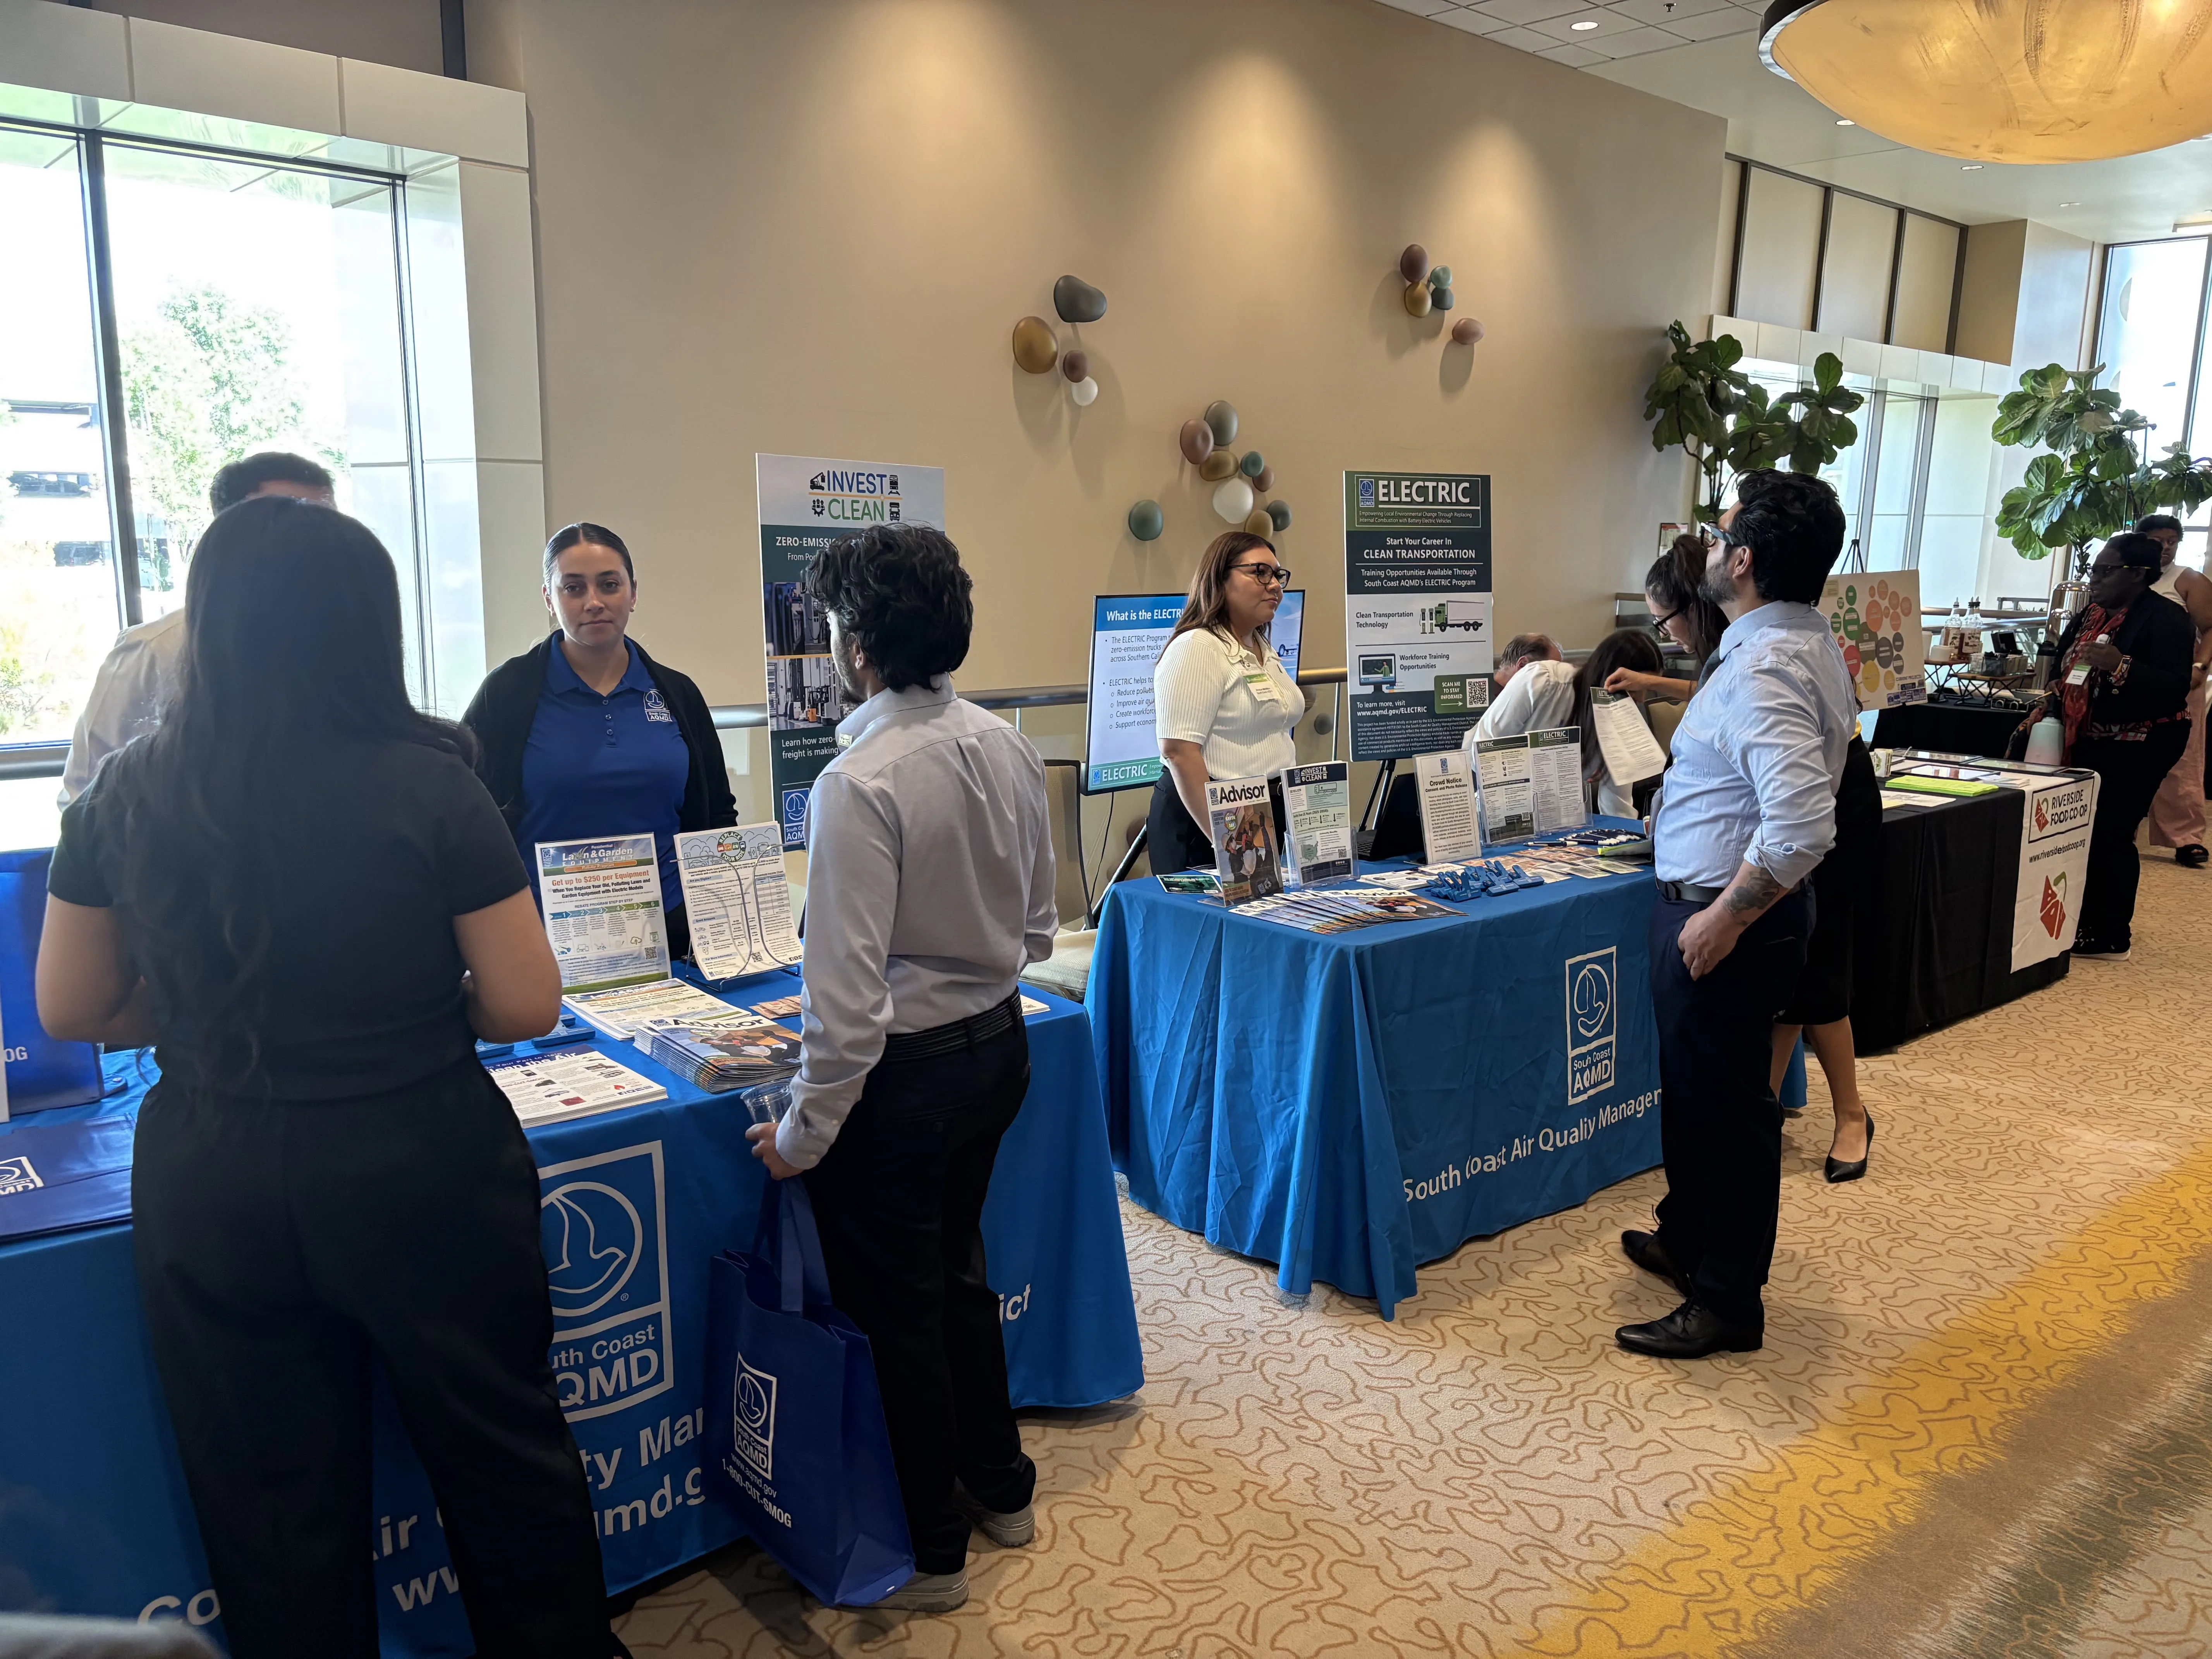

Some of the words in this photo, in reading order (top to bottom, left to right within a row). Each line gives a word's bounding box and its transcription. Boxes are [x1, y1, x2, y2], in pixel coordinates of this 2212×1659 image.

[827, 470, 887, 494] INVEST
[1378, 480, 1470, 503] ELECTRIC
[828, 498, 884, 522] CLEAN
[776, 537, 836, 548] ZERO-EMISSI
[788, 553, 804, 561] From
[1364, 550, 1393, 558] CLEAN
[1396, 550, 1475, 558] TRANSPORTATION
[1361, 569, 1384, 577] Training
[1386, 568, 1425, 577] Opportunities
[1453, 568, 1477, 577] Through
[1453, 579, 1475, 587] Program
[1106, 610, 1128, 621] What
[1130, 610, 1137, 620] is
[1139, 610, 1151, 620] the
[1154, 608, 1183, 619] ELECTRI
[1373, 611, 1413, 619] Transportation
[1356, 621, 1388, 629] Technology
[1111, 644, 1145, 653] zero-emission
[1109, 678, 1132, 686] ELECTRIC
[1133, 677, 1146, 685] helps
[1357, 706, 1427, 716] www.aqmd.gov/ELECTRIC
[1115, 721, 1135, 730] Support
[1544, 731, 1566, 739] ELECTRIC
[782, 749, 805, 760] freight
[807, 748, 812, 756] is
[814, 746, 838, 755] making
[1103, 764, 1147, 781] ELECTRIC
[1430, 778, 1445, 787] Crowd
[1220, 784, 1265, 804] Advisor
[2052, 789, 2083, 809] RIVERSIDE
[2051, 810, 2069, 826] FOOD
[719, 832, 741, 843] REPLACE
[787, 831, 804, 841] AQM
[563, 851, 589, 861] Lawn
[591, 850, 598, 858] &
[598, 848, 633, 857] Garden
[722, 853, 735, 862] YOUR
[735, 850, 744, 860] RIDE
[2029, 838, 2086, 863] www.riversidefoodcoop.org
[584, 875, 600, 883] $250
[615, 870, 649, 880] Equipment
[673, 1018, 764, 1028] Advisor
[1573, 1054, 1591, 1071] Souh
[1593, 1047, 1610, 1062] Coast
[1573, 1060, 1610, 1093] AQMD
[1403, 1163, 1461, 1202] South
[1511, 1135, 1534, 1163] Air
[551, 1348, 583, 1369] uth
[591, 1324, 655, 1360] Coast
[556, 1348, 658, 1407] QMD
[737, 1434, 768, 1469] AQMD
[750, 1437, 767, 1455] Coast
[731, 1453, 777, 1498] www.aqmd.gov
[722, 1458, 792, 1528] 1-800-CUT-SMOG
[373, 1515, 417, 1561] ir
